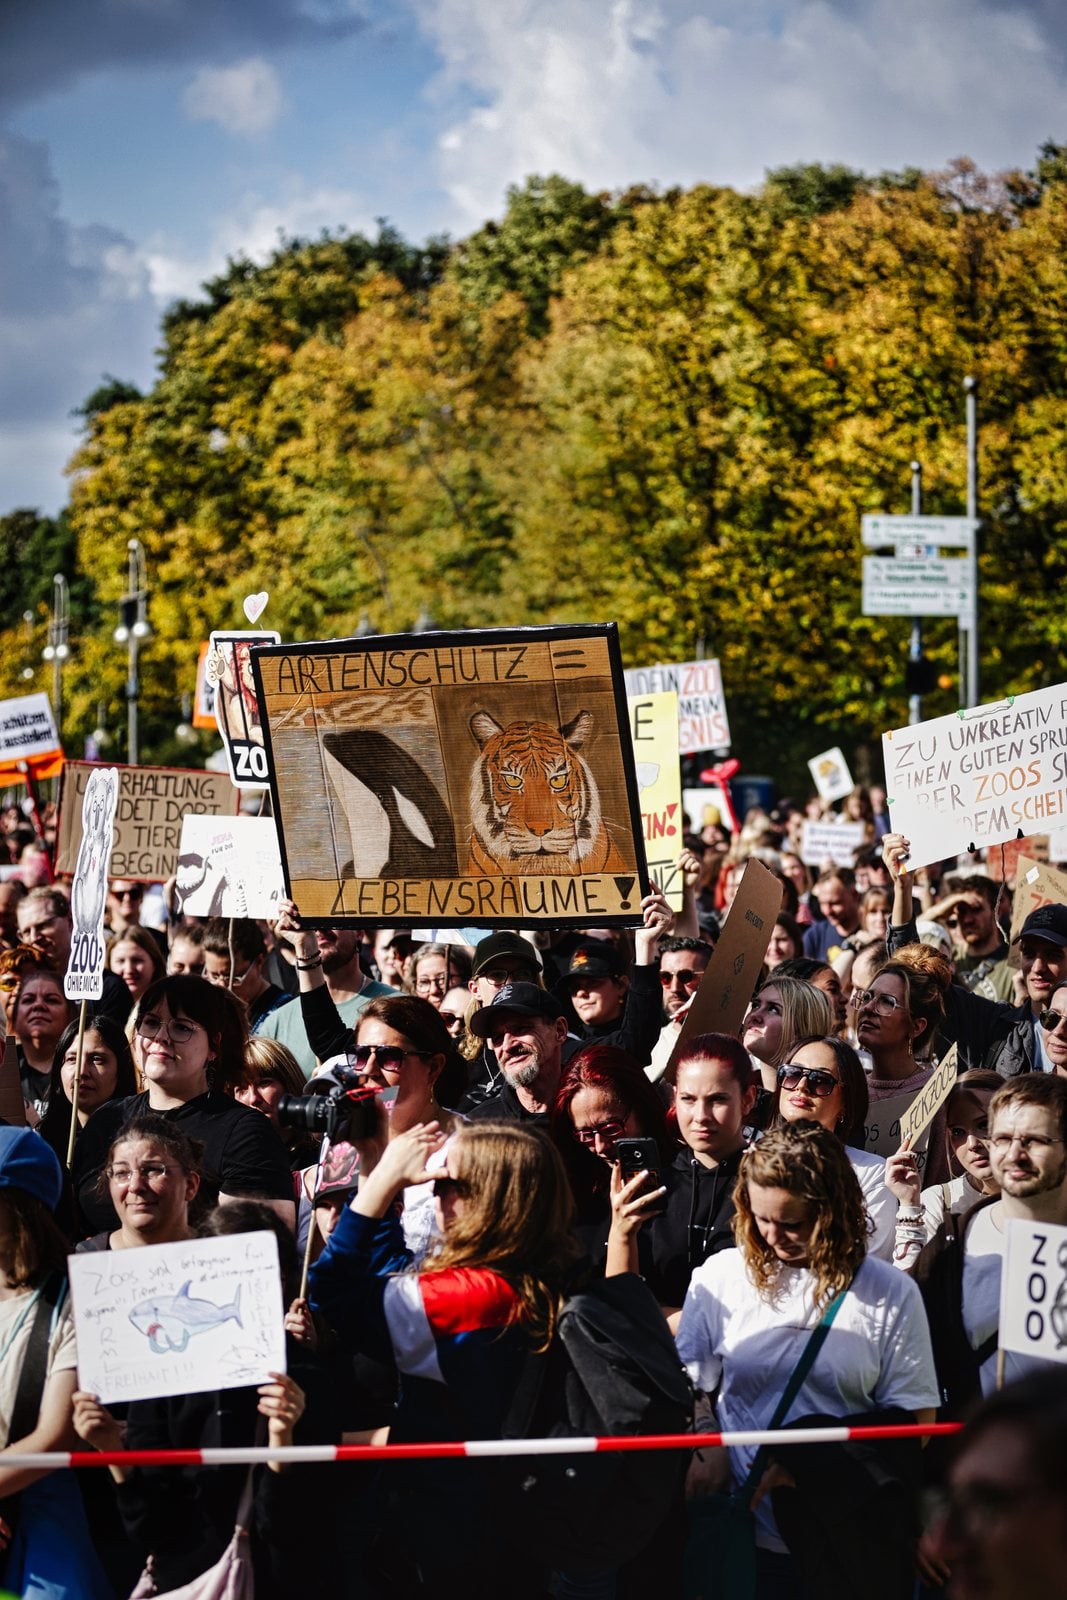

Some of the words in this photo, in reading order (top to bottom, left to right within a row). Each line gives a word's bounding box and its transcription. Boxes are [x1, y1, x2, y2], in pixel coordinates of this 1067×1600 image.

[278, 646, 529, 693] ARTENSCHUTZ
[683, 664, 719, 696] ZOO
[895, 736, 937, 769] ZU
[949, 704, 1054, 751] UNKREATIV
[960, 739, 1024, 774] GUTEN
[972, 760, 1042, 803] ZOOS
[71, 934, 103, 973] ZOO?
[1026, 1233, 1047, 1341] ZOO
